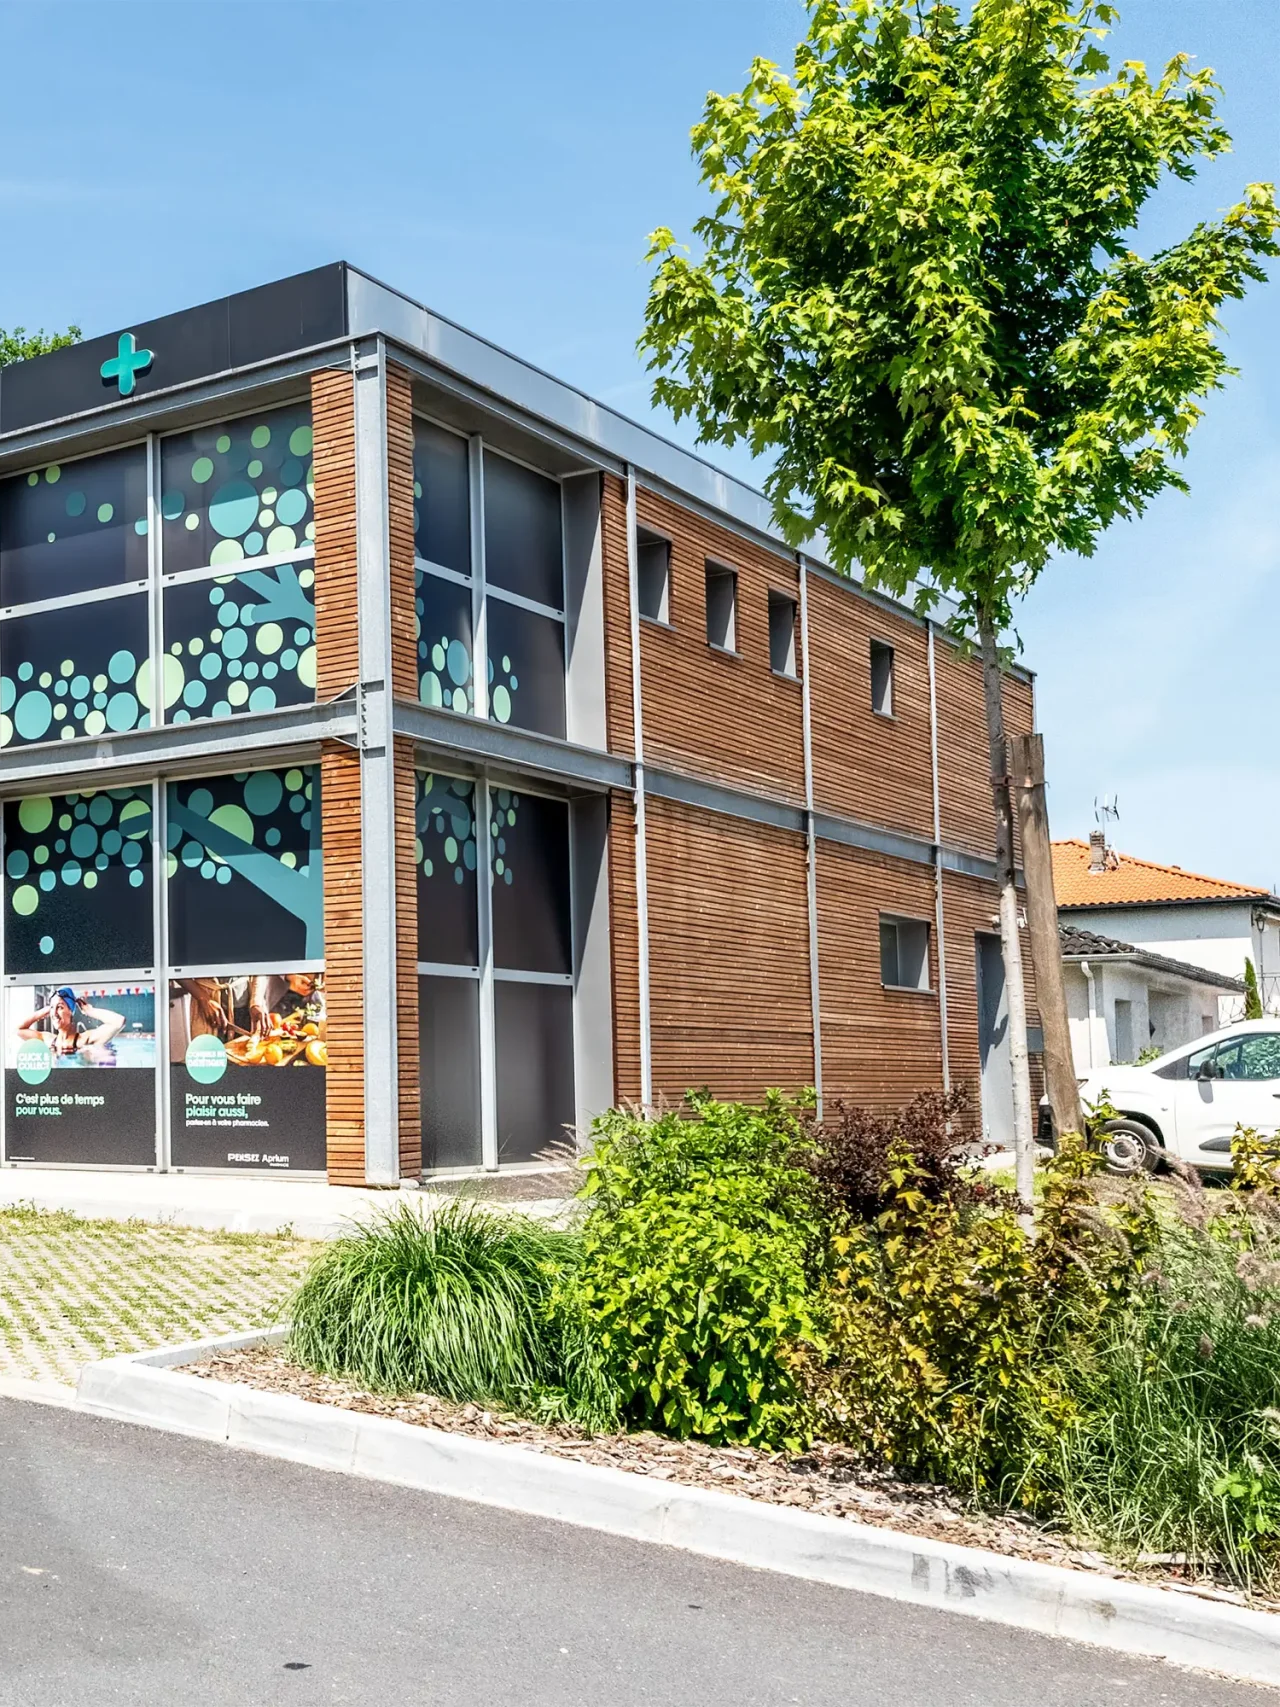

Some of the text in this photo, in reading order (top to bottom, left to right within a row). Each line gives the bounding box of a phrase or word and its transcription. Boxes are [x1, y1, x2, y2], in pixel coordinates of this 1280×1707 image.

[15, 1093, 105, 1107] C'est plus de temps
[185, 1093, 262, 1105] Pour vous faire
[15, 1106, 62, 1117] pour vous.
[185, 1105, 248, 1119] plaisir aussi,
[261, 1154, 290, 1164] Aprium
